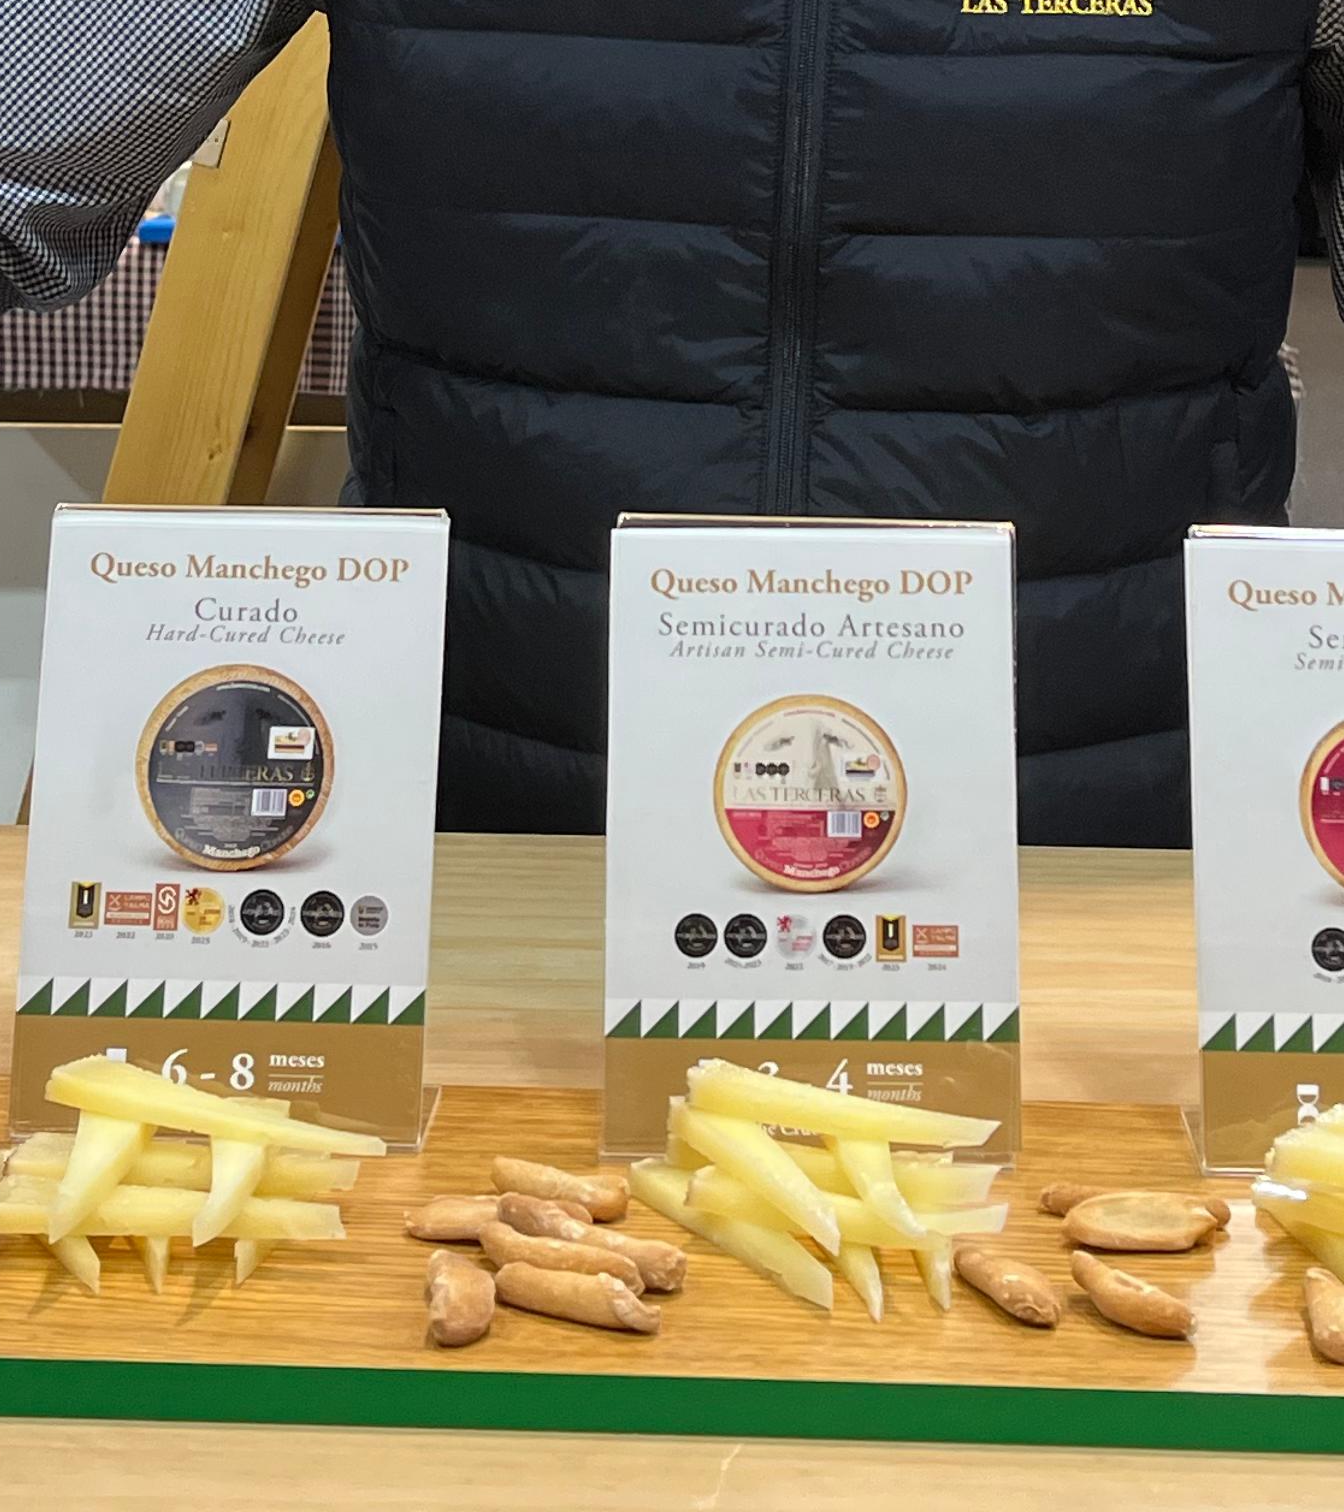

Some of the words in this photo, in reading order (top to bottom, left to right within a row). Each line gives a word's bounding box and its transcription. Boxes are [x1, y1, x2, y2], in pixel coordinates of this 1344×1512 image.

[90, 552, 176, 583] Queso
[185, 554, 327, 589] Manchego
[337, 557, 410, 583] DOP
[650, 568, 738, 600] Queso
[746, 569, 891, 603] Manchego
[899, 570, 973, 595] DOP
[1228, 579, 1317, 611] Queso
[194, 597, 299, 623] Curado
[145, 624, 271, 644] Hard-Cured
[279, 627, 346, 646] Cheese
[658, 612, 826, 638] Semicurado
[837, 614, 965, 638] Artesano
[669, 641, 746, 659] Artisan
[755, 641, 877, 660] Semi-Cured
[886, 642, 955, 660] Cheese
[161, 1048, 188, 1086] 6
[229, 1053, 255, 1091] 8
[269, 1054, 325, 1069] meses
[825, 1058, 854, 1096] 4
[866, 1062, 924, 1076] meses
[267, 1076, 324, 1093] months
[866, 1084, 922, 1102] months
